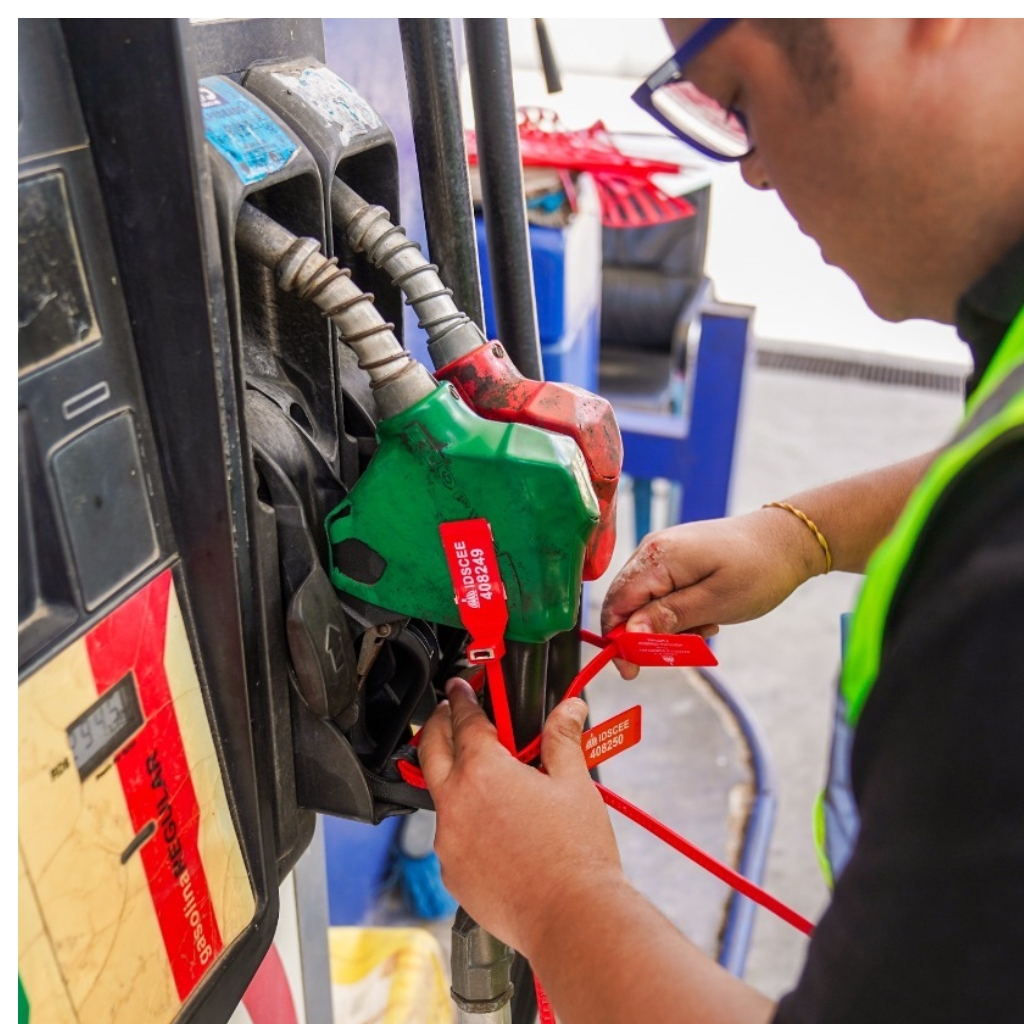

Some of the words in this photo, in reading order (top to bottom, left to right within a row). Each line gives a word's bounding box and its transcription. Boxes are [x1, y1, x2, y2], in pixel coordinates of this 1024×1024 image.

[454, 540, 475, 589] IDSCEE
[470, 548, 493, 600] 408249
[598, 719, 630, 743] IDSCEE
[145, 748, 187, 879] REGULAR
[179, 869, 213, 965] gasolina
